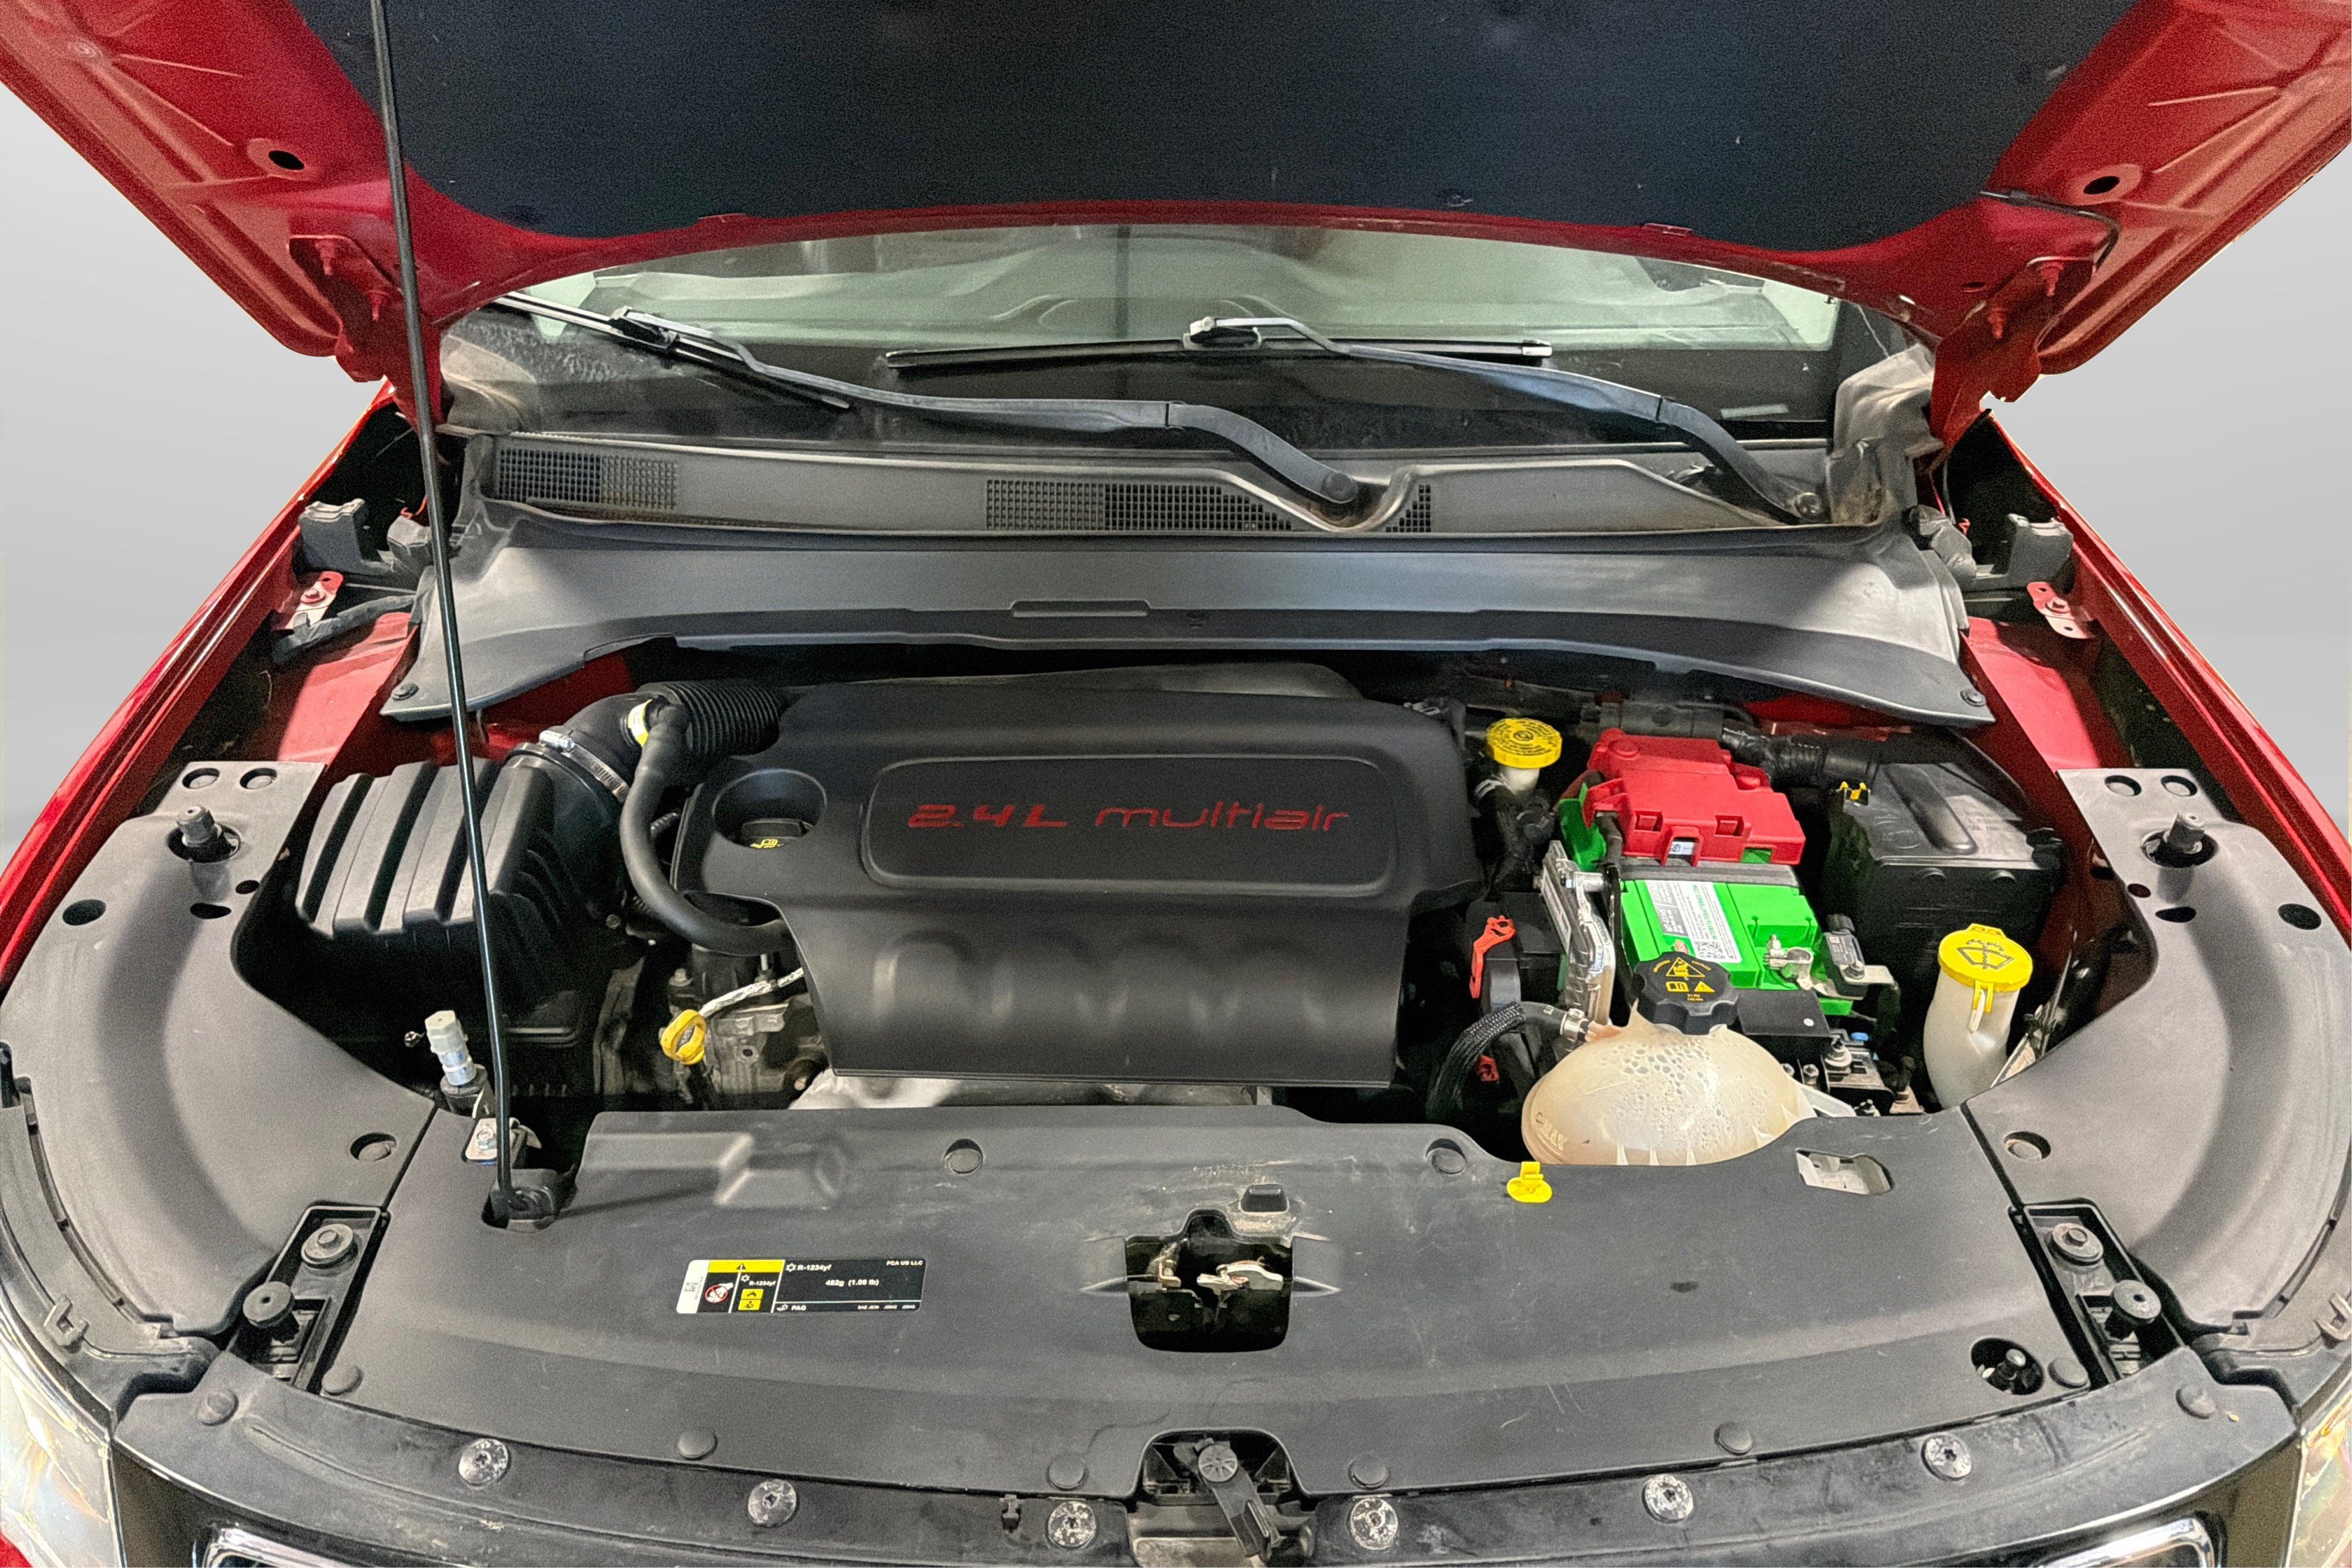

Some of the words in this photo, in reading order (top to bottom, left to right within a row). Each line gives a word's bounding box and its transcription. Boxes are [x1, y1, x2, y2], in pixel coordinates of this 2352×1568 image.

[1095, 801, 1349, 831] multiair
[797, 1264, 832, 1272] R-1234yf
[869, 1279, 879, 1287] lb)
